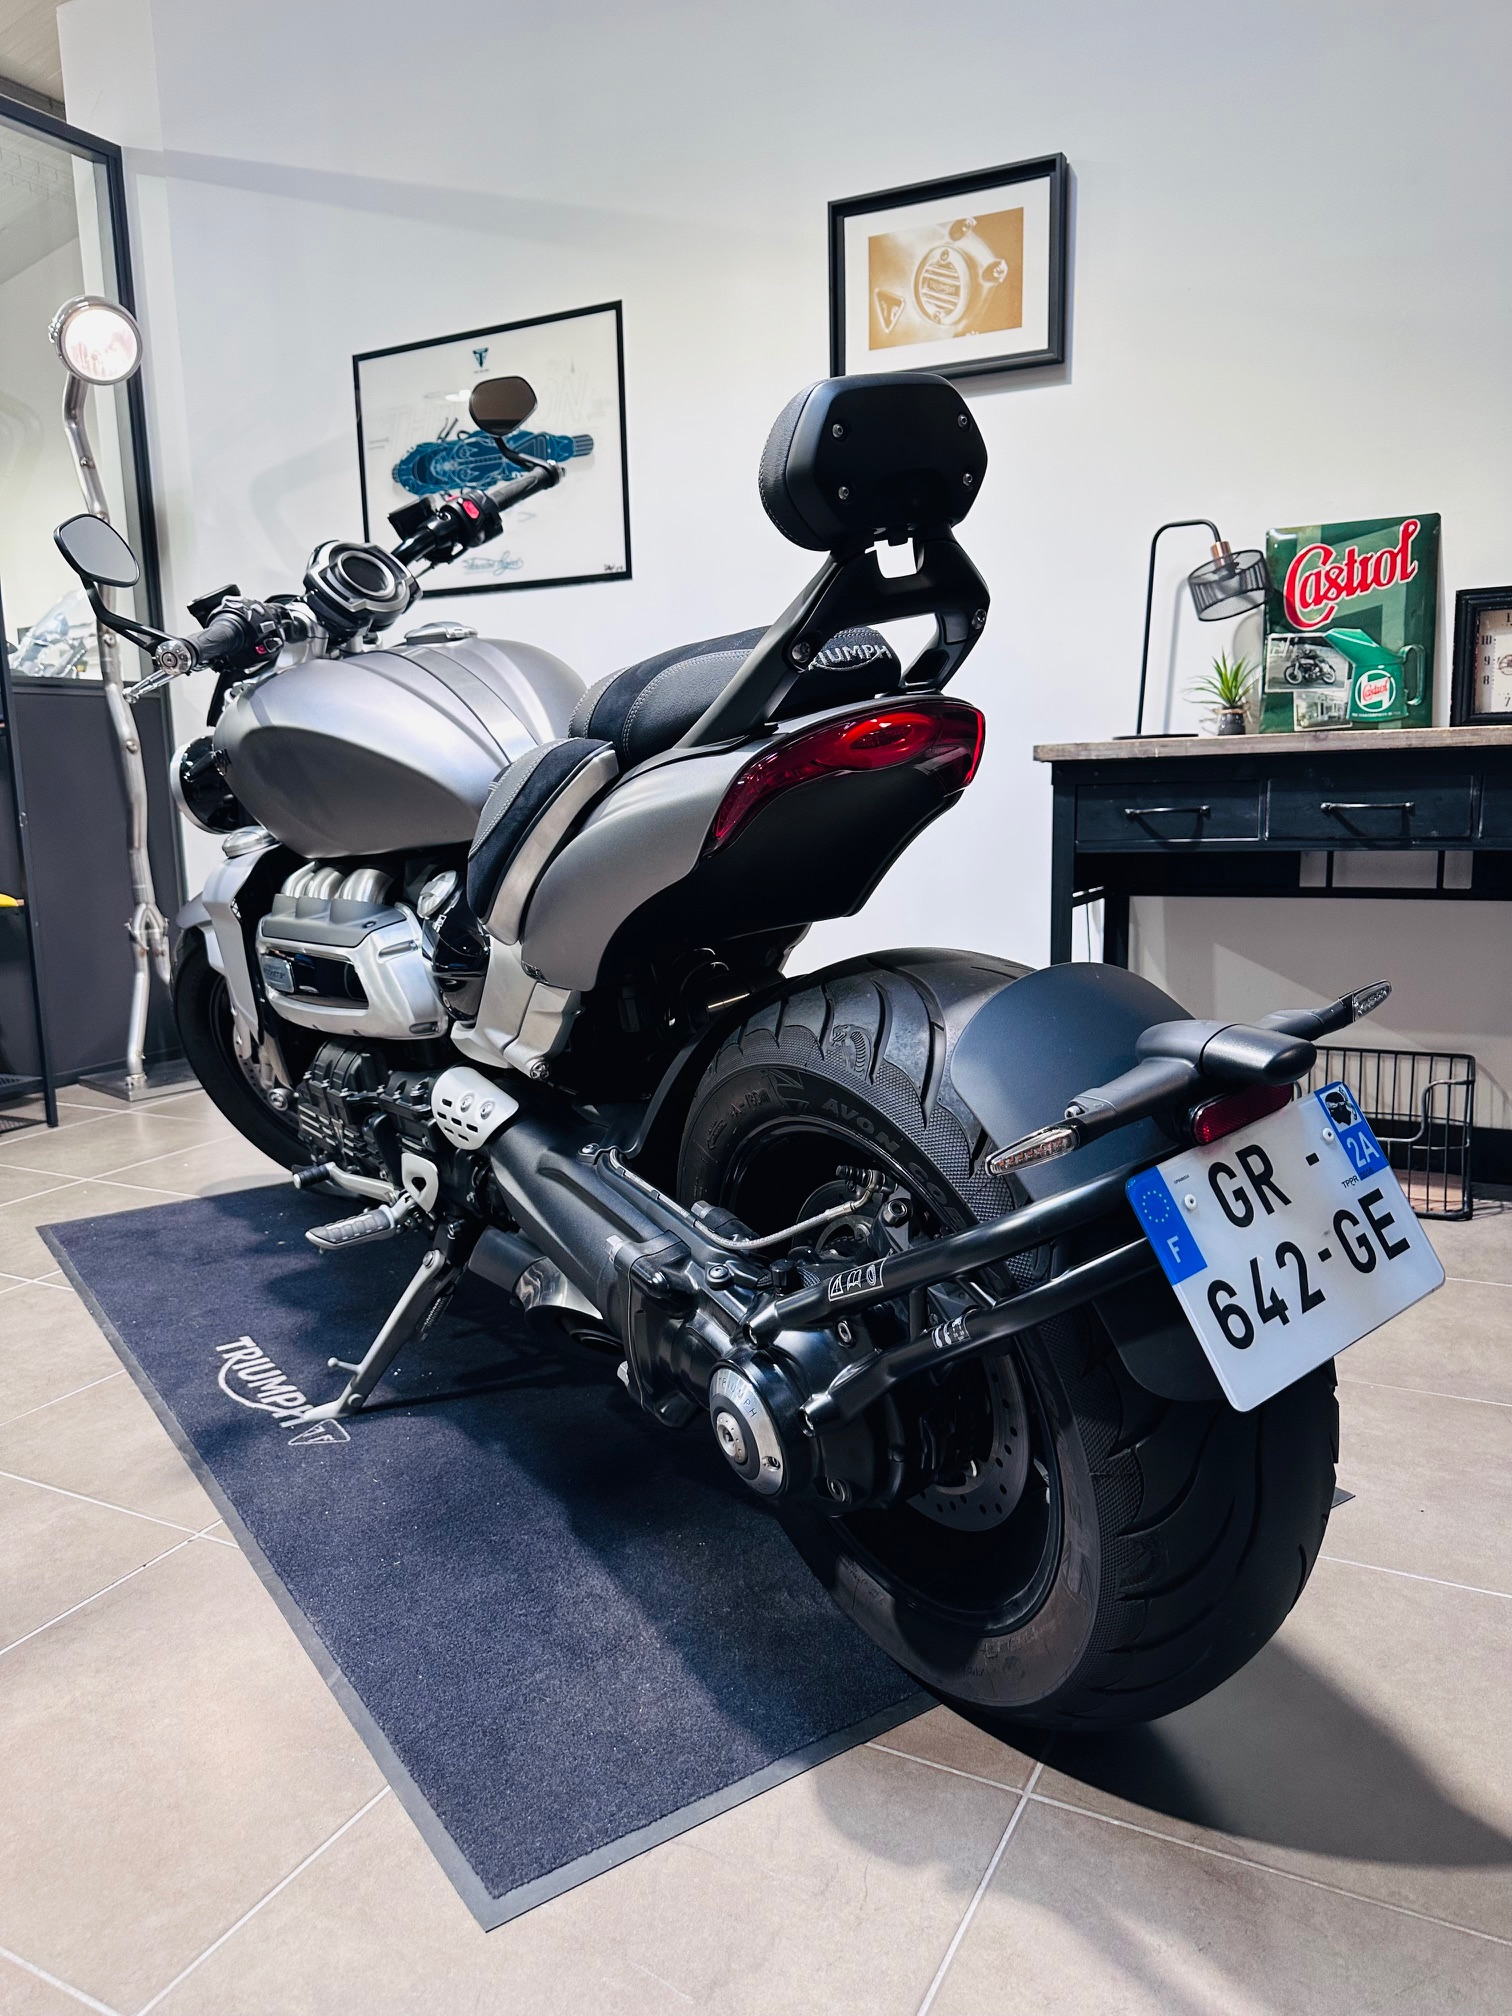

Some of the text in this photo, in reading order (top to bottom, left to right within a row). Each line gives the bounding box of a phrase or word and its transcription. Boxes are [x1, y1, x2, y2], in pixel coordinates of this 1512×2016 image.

[1284, 519, 1420, 630] Castrol
[808, 644, 893, 671] IUMPH
[821, 1098, 900, 1153] AVON
[1346, 1131, 1380, 1168] 2A
[1208, 1144, 1292, 1228] GR
[1166, 1235, 1181, 1264] F
[1207, 1188, 1411, 1350] 642-GE
